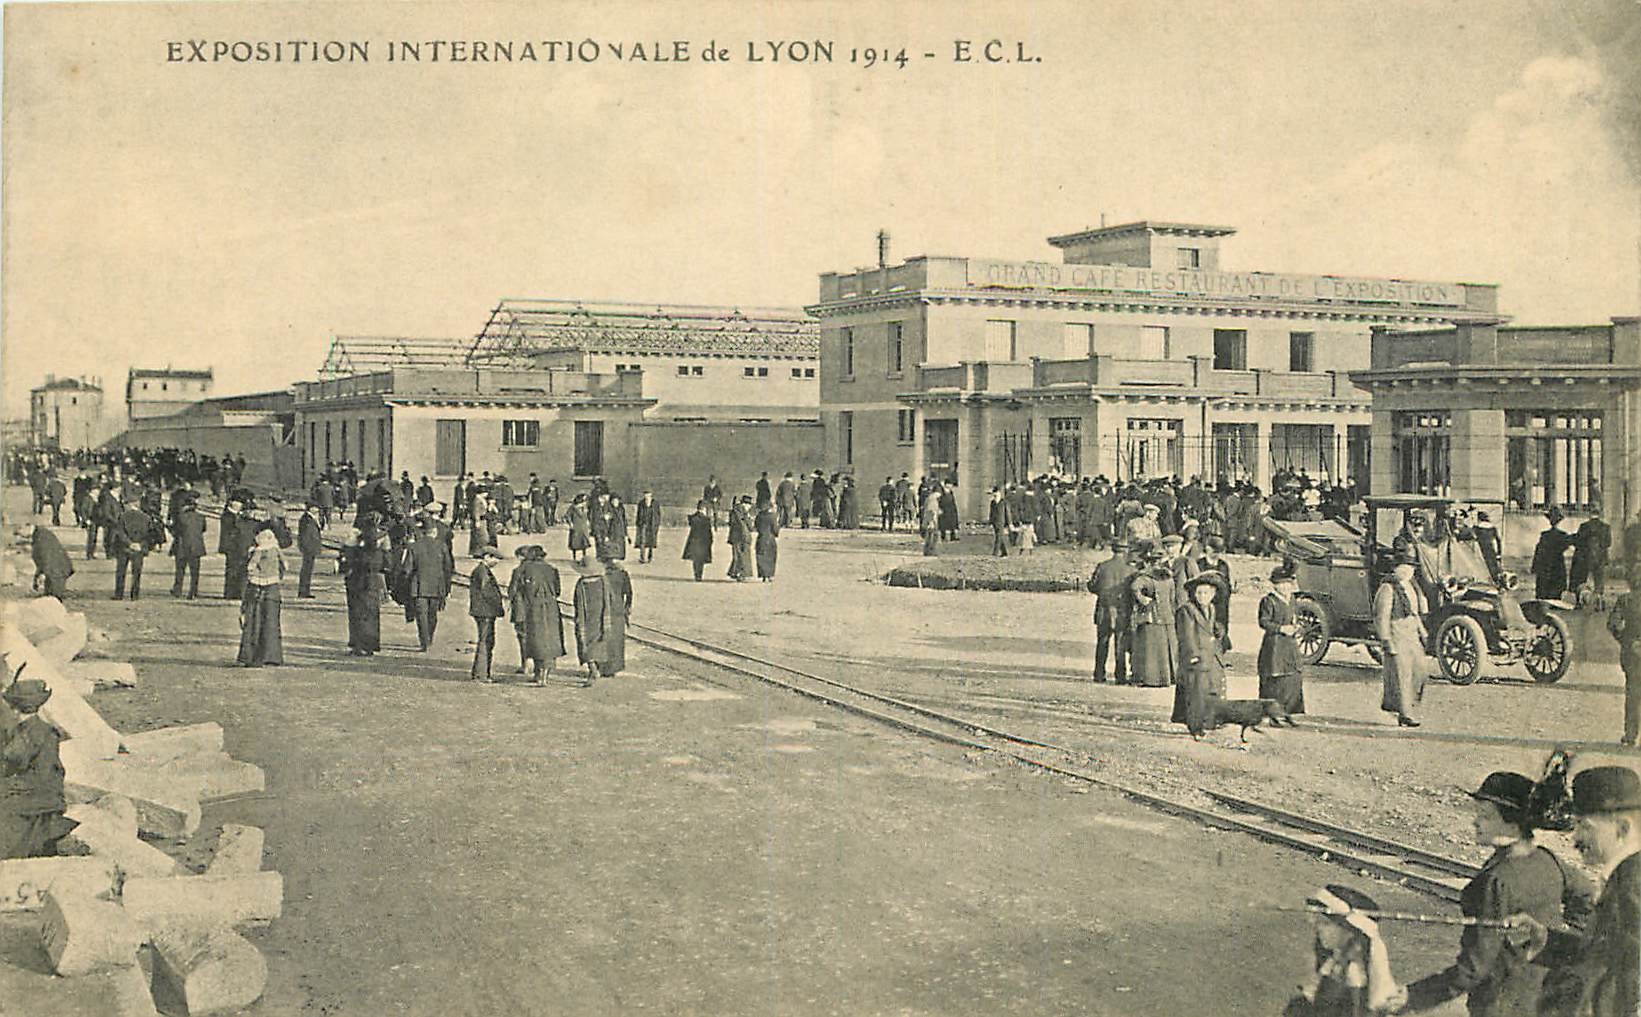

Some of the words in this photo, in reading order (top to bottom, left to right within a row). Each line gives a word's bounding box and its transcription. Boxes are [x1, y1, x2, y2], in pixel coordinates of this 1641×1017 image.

[987, 264, 1062, 286] GRAND
[1135, 270, 1269, 295] RESTAURANT
[1279, 278, 1302, 295] DE
